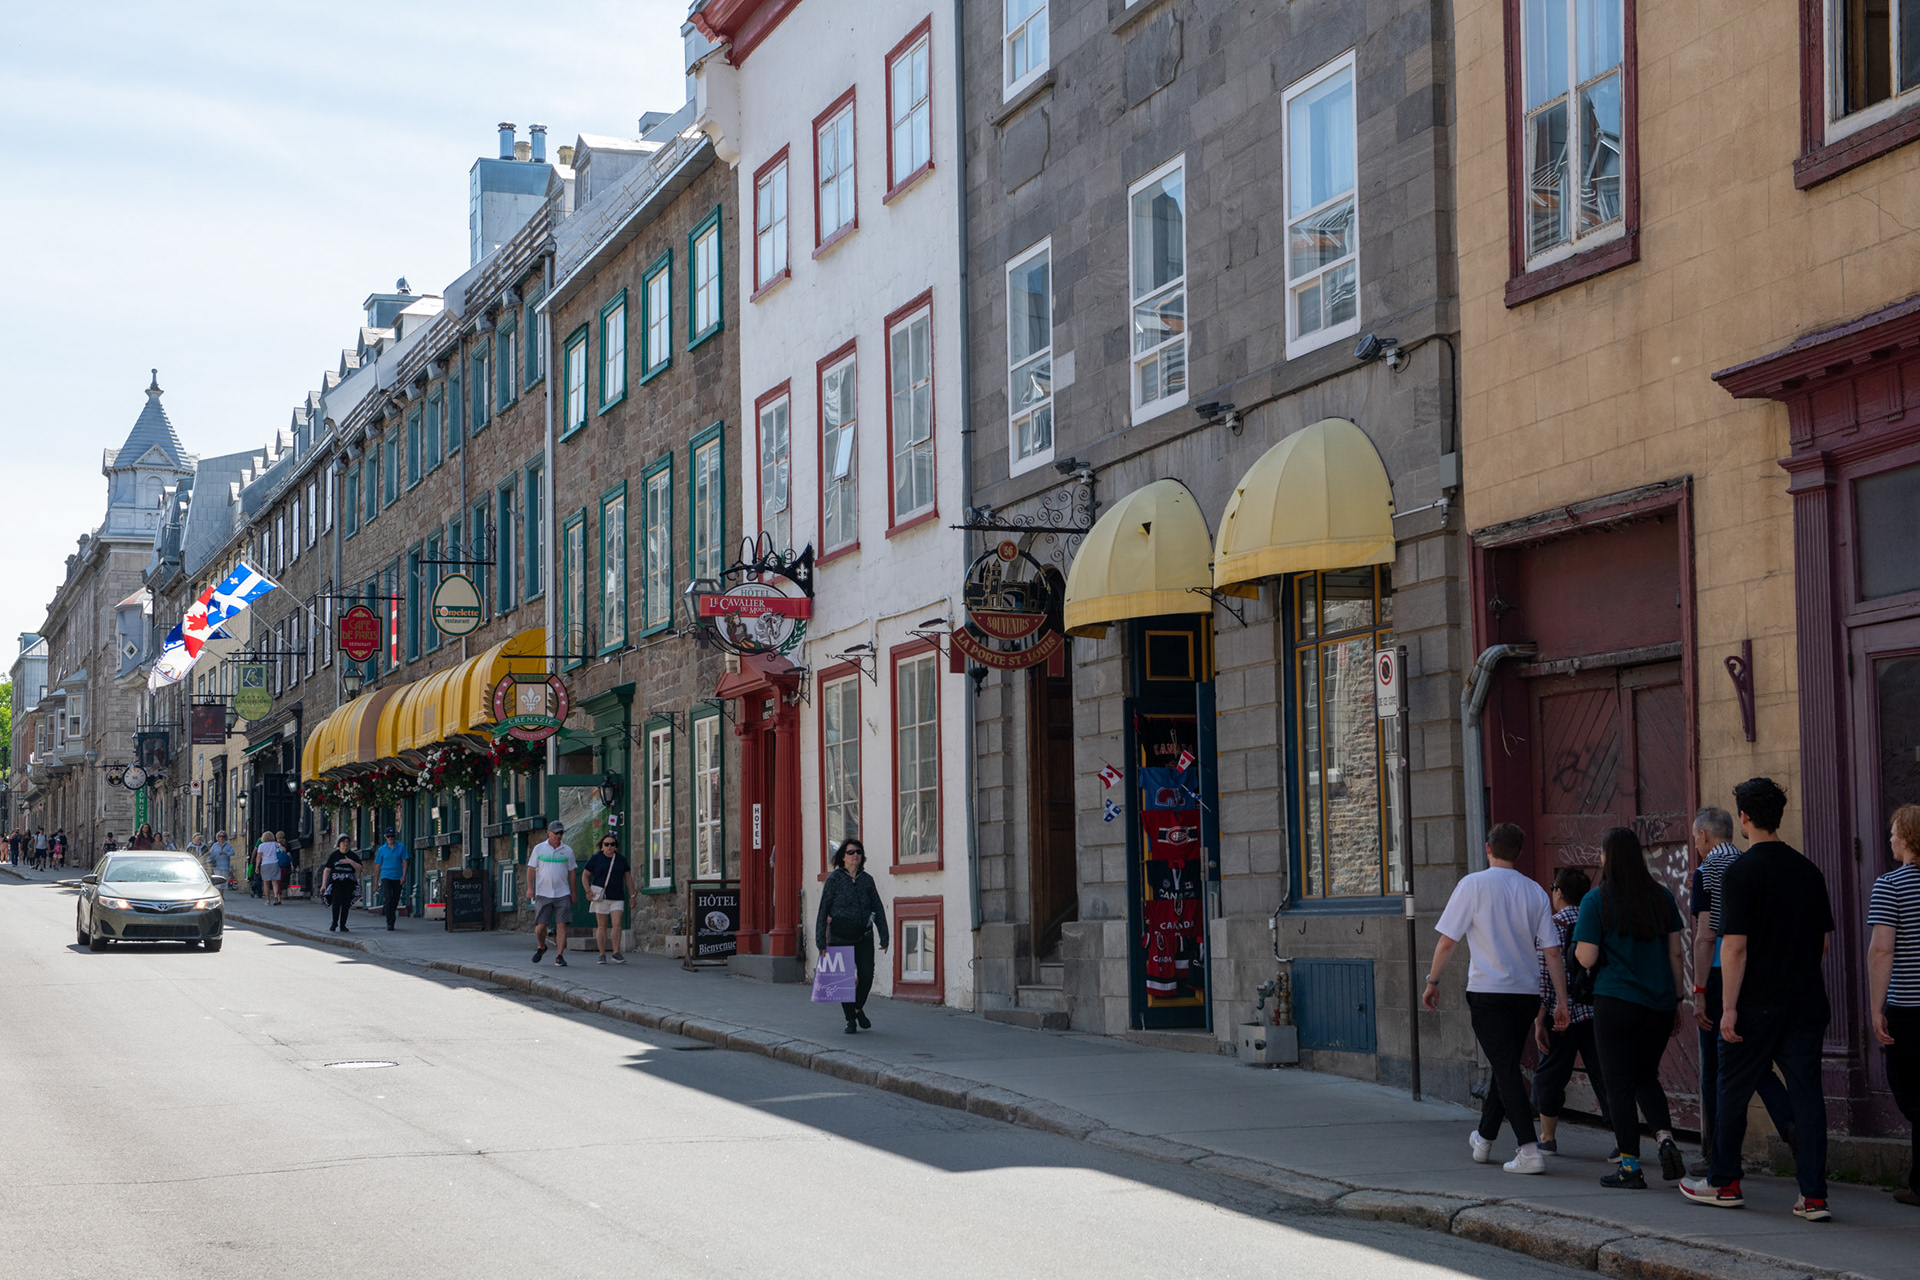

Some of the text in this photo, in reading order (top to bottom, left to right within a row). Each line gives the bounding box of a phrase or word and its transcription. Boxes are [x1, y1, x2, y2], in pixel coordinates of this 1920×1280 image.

[1004, 546, 1013, 556] 56
[741, 587, 770, 597] HÔTEL
[710, 598, 766, 610] LE CAVALIER
[986, 618, 1030, 635] SOUVENIRS
[342, 630, 378, 640] DE PARIS
[956, 632, 1056, 666] LA PORTE ST-LOUIS
[1378, 698, 1383, 706] DE
[1383, 697, 1388, 706] CE
[699, 894, 737, 907] HÔTEL
[699, 941, 737, 954] Bienvenue
